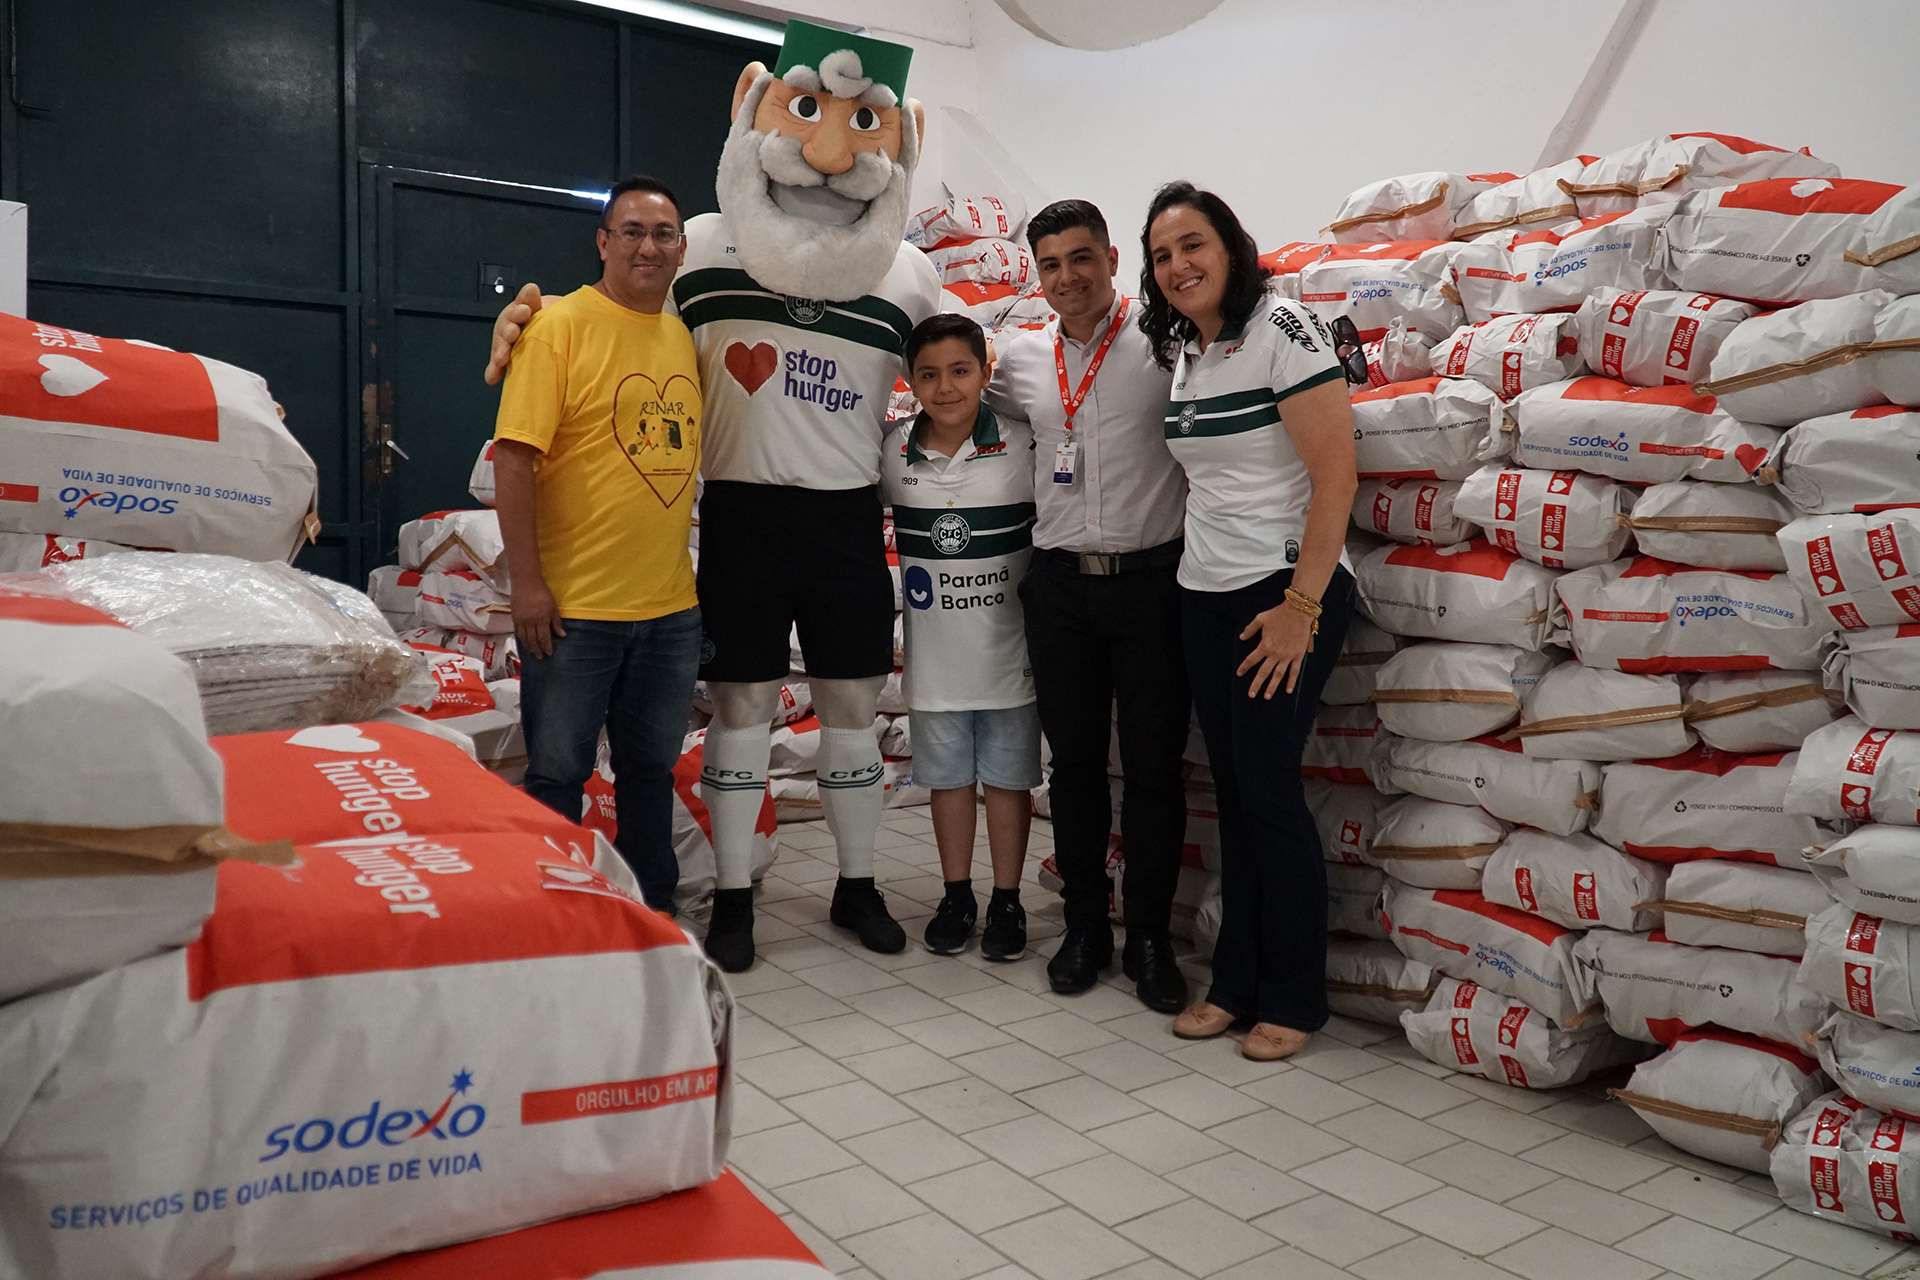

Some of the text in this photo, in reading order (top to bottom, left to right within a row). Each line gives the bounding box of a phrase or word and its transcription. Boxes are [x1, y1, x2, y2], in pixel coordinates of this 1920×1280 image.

[1534, 258, 1588, 279] sodexo
[1352, 287, 1393, 299] sodexo
[1268, 312, 1303, 343] TORK
[1274, 306, 1304, 330] PRO
[1674, 329, 1685, 348] stop
[1681, 320, 1697, 350] hunger
[784, 349, 837, 384] stop
[784, 371, 863, 413] hunger
[1568, 433, 1629, 452] sodexo
[62, 467, 272, 506] SERVIÇOS DE QUALIDADE DE VIDA
[901, 477, 918, 486] 1909
[59, 487, 178, 514] sodexo
[940, 529, 960, 539] CFC
[1872, 537, 1883, 557] stop
[1811, 553, 1823, 573] stop
[939, 566, 1009, 588] Paraná
[941, 594, 1005, 610] Banco
[1676, 606, 1738, 620] sodexo
[361, 758, 431, 800] stop
[704, 766, 753, 780] CFC
[830, 762, 879, 780] CFC
[595, 793, 616, 807] sto
[397, 843, 473, 874] stop
[336, 846, 441, 919] hunger
[1889, 1077, 1900, 1086] DE
[575, 1084, 660, 1112] ORGULHO
[665, 1079, 689, 1099] EM
[258, 1092, 486, 1164] sodexo
[50, 1152, 482, 1231] SERVIÇOS DE QUALIDADE DE VIDA
[1874, 1176, 1886, 1198] stop
[1883, 1163, 1896, 1200] hunger
